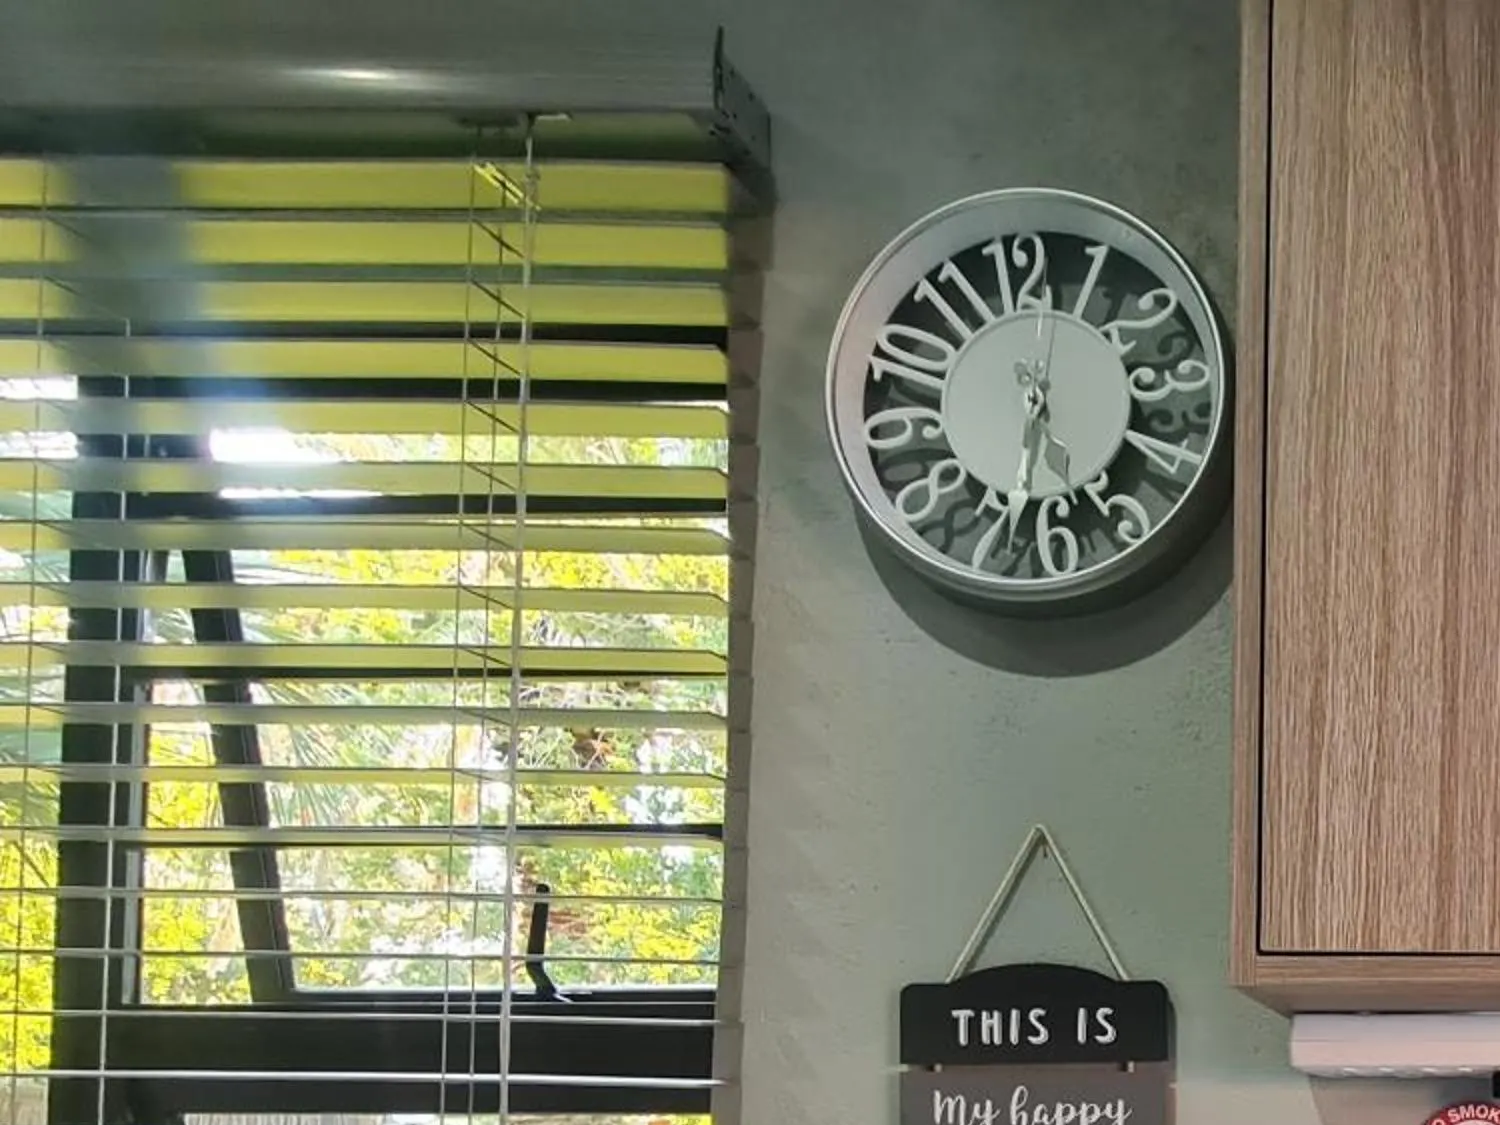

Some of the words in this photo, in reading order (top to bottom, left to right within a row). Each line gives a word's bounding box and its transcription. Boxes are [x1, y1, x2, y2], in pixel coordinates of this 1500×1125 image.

[914, 259, 996, 343] 11
[982, 232, 1050, 313] 12
[1071, 244, 1109, 320] 1
[1100, 287, 1177, 354] 2
[869, 323, 958, 388] 10
[1130, 359, 1210, 401] 3
[865, 408, 944, 449] 9
[1124, 429, 1202, 473] 4
[896, 459, 966, 521] 8
[1084, 471, 1150, 542] 5
[972, 487, 1010, 570] 7
[1036, 495, 1080, 575] 6
[952, 1008, 1049, 1046] THIS
[1077, 1007, 1117, 1044] IS
